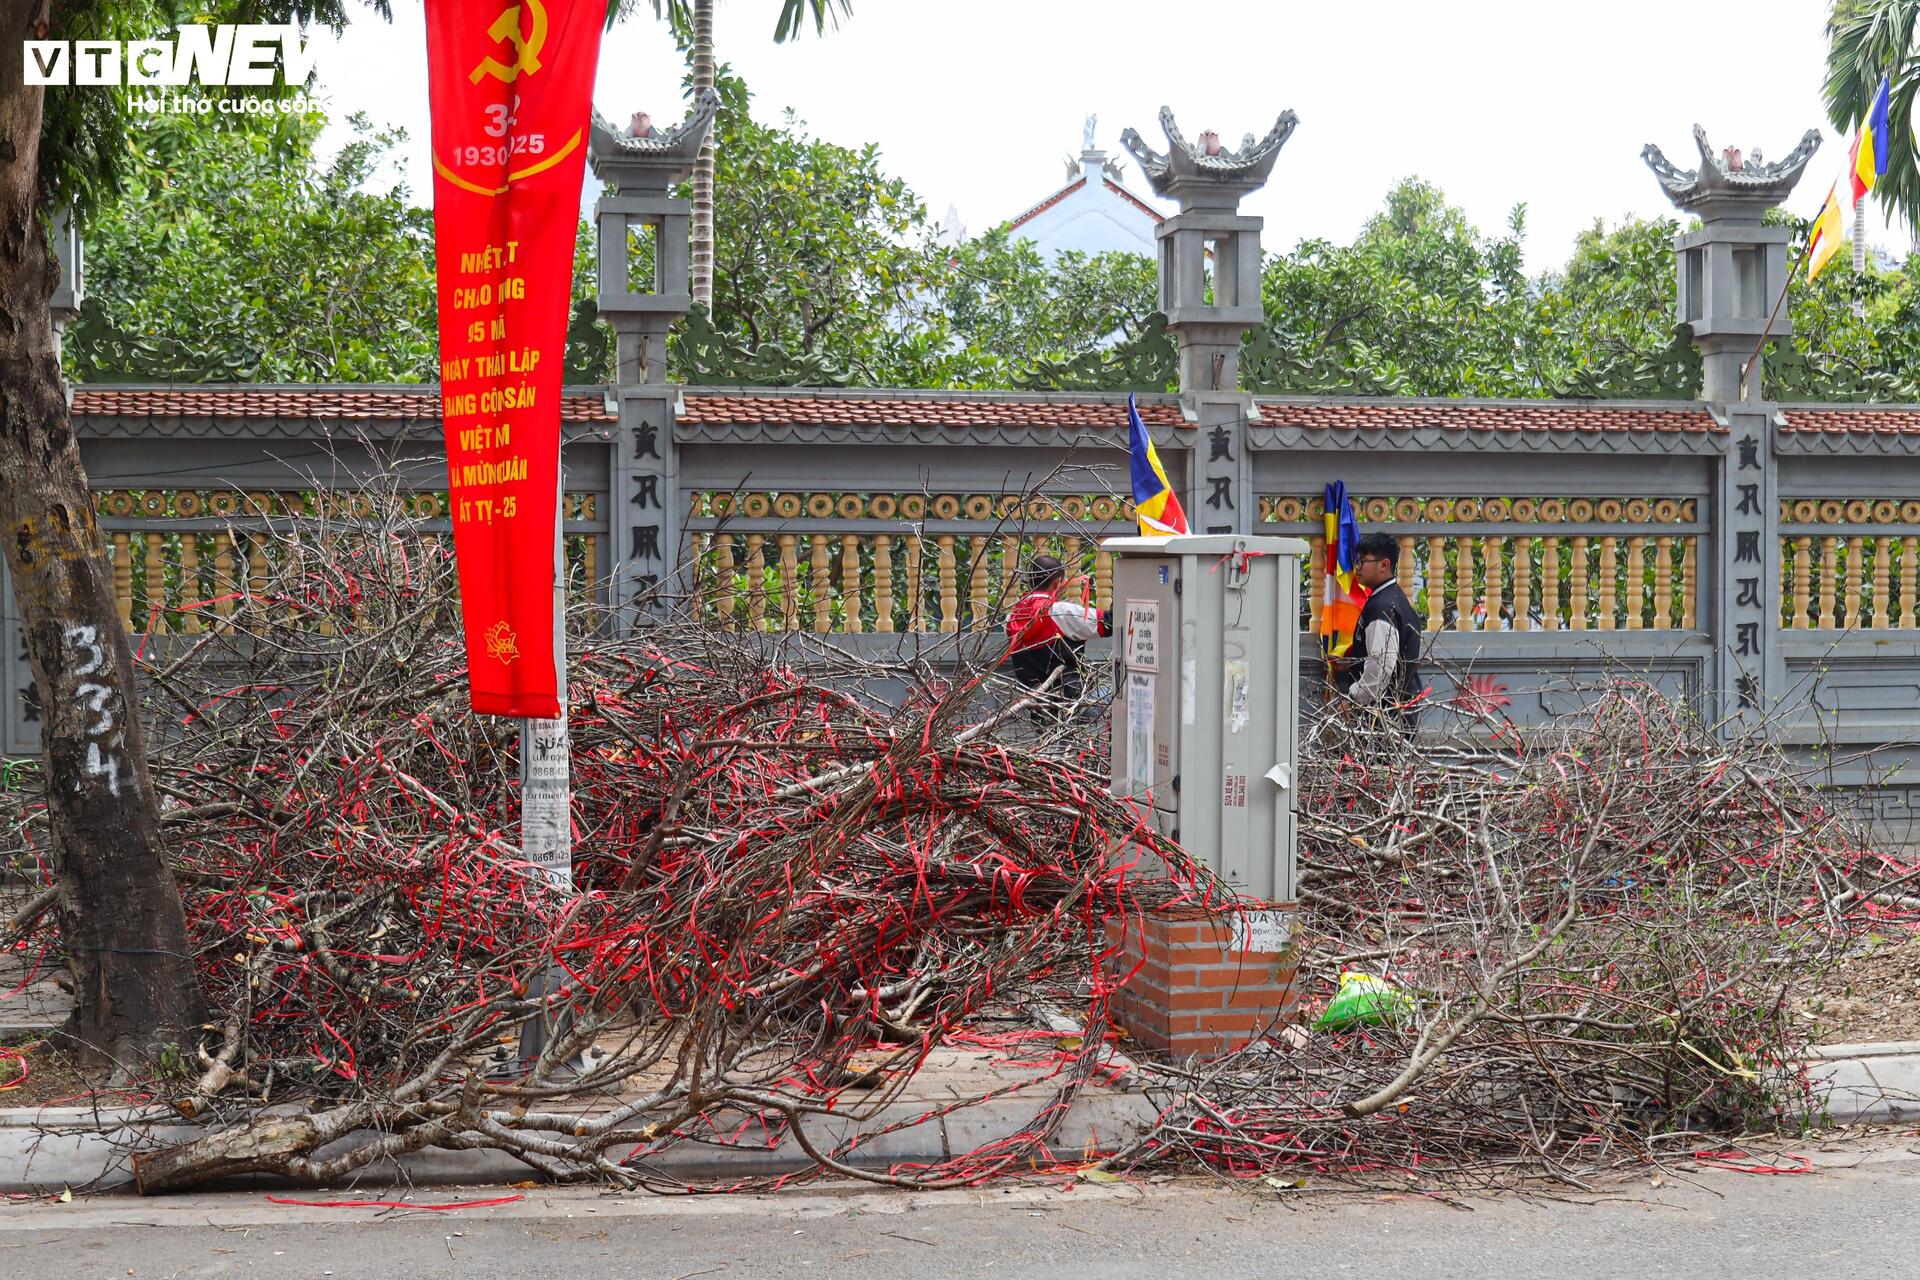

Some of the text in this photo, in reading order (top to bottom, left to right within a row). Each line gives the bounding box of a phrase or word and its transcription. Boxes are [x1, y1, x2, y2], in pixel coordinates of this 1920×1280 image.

[509, 347, 541, 377] LẬP
[504, 380, 536, 409] SẢN
[459, 424, 493, 455] VIỆT
